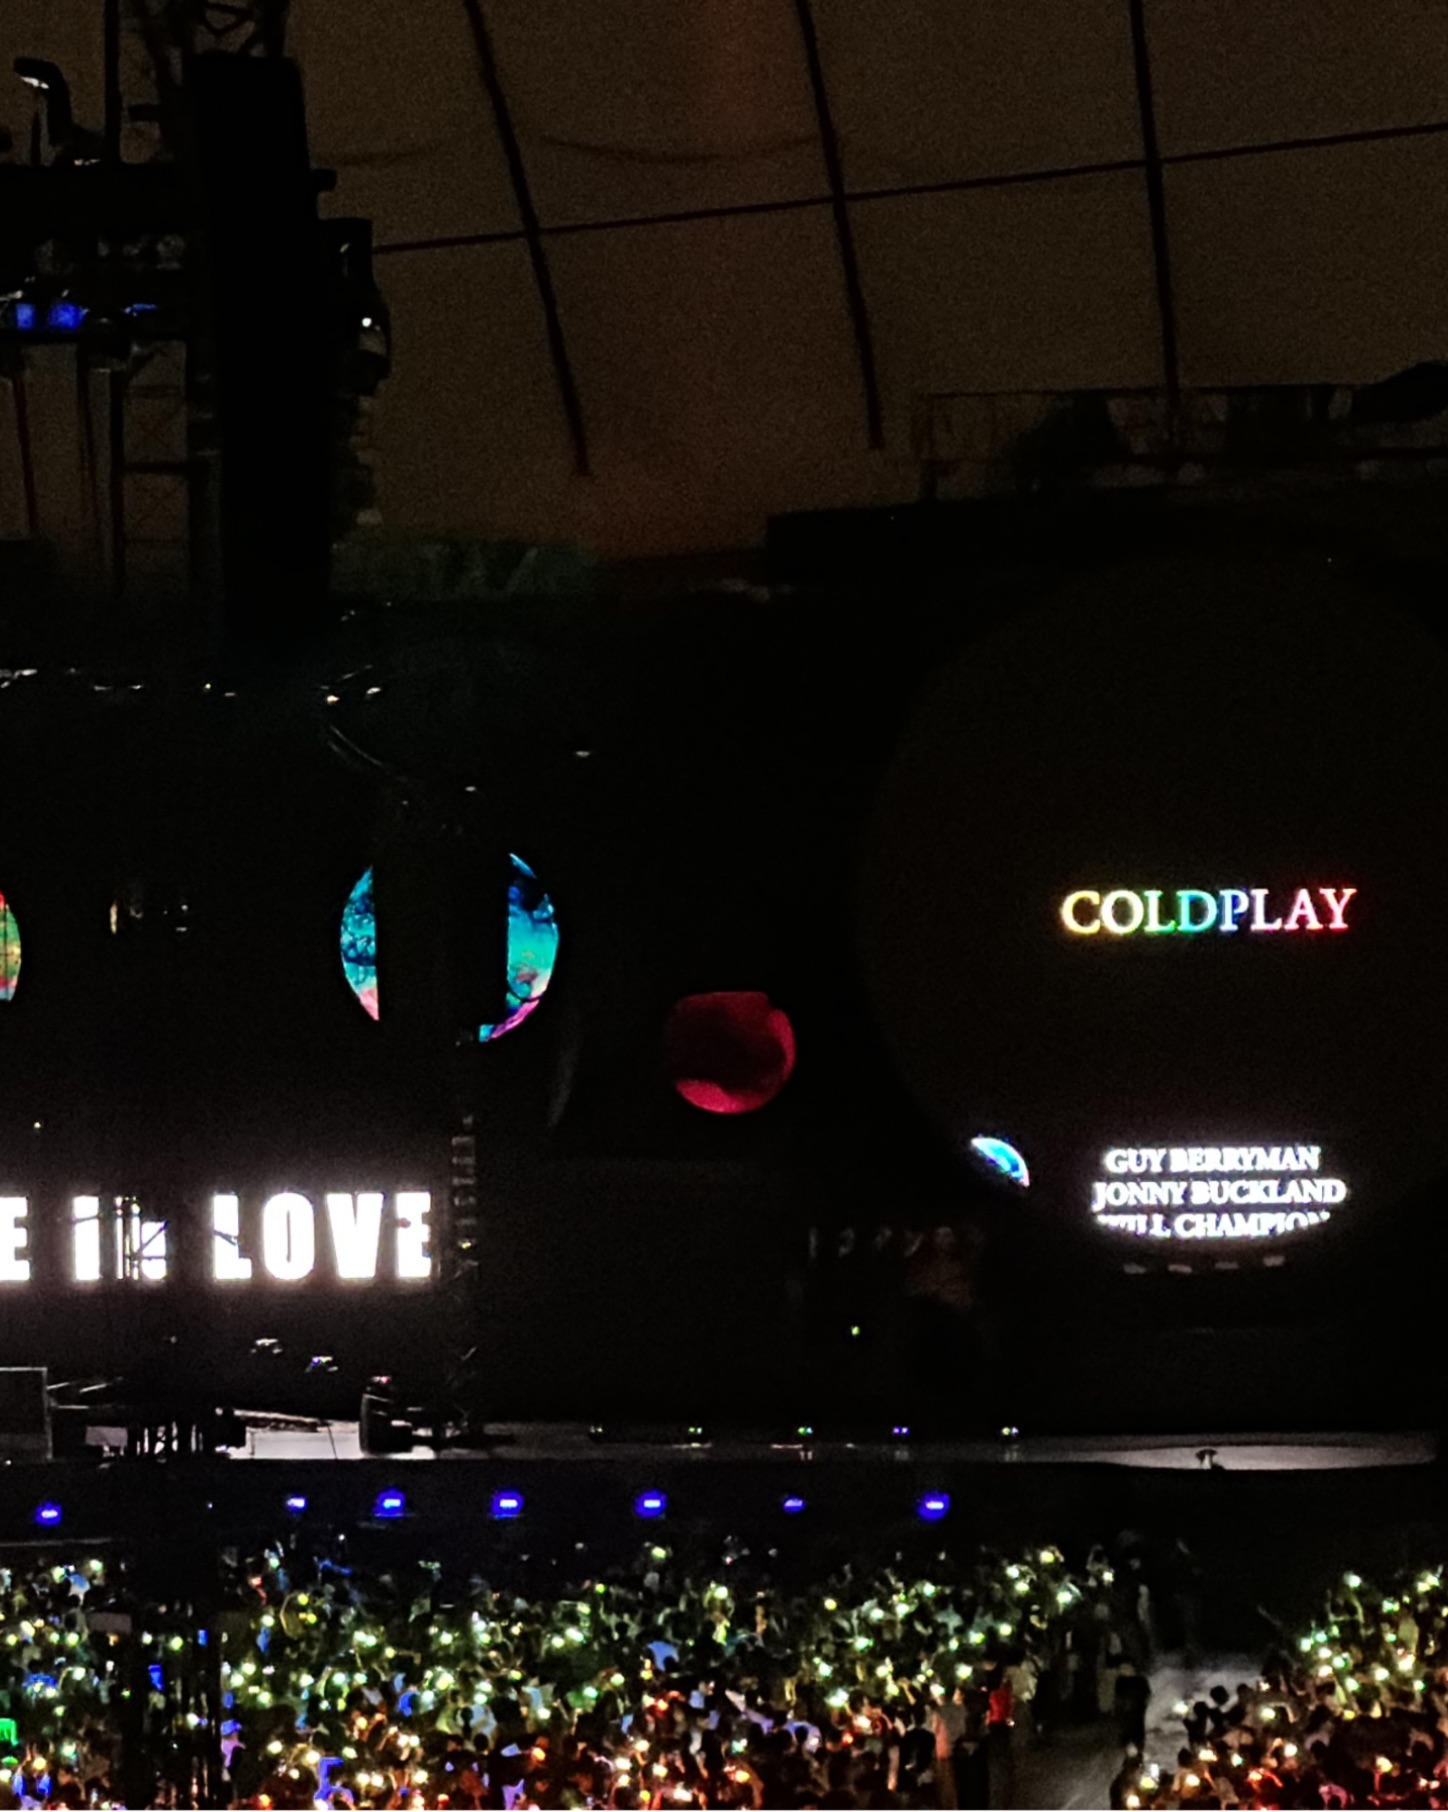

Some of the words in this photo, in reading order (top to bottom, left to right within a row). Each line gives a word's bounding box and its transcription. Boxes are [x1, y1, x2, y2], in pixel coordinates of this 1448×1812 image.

[1061, 888, 1357, 934] COLDPLAY
[1105, 1148, 1166, 1173] GUY
[1168, 1146, 1321, 1172] BERRYMAN
[1092, 1181, 1188, 1211] JONNY
[1190, 1179, 1347, 1204] BUCKLAND
[213, 1192, 432, 1281] LOVE
